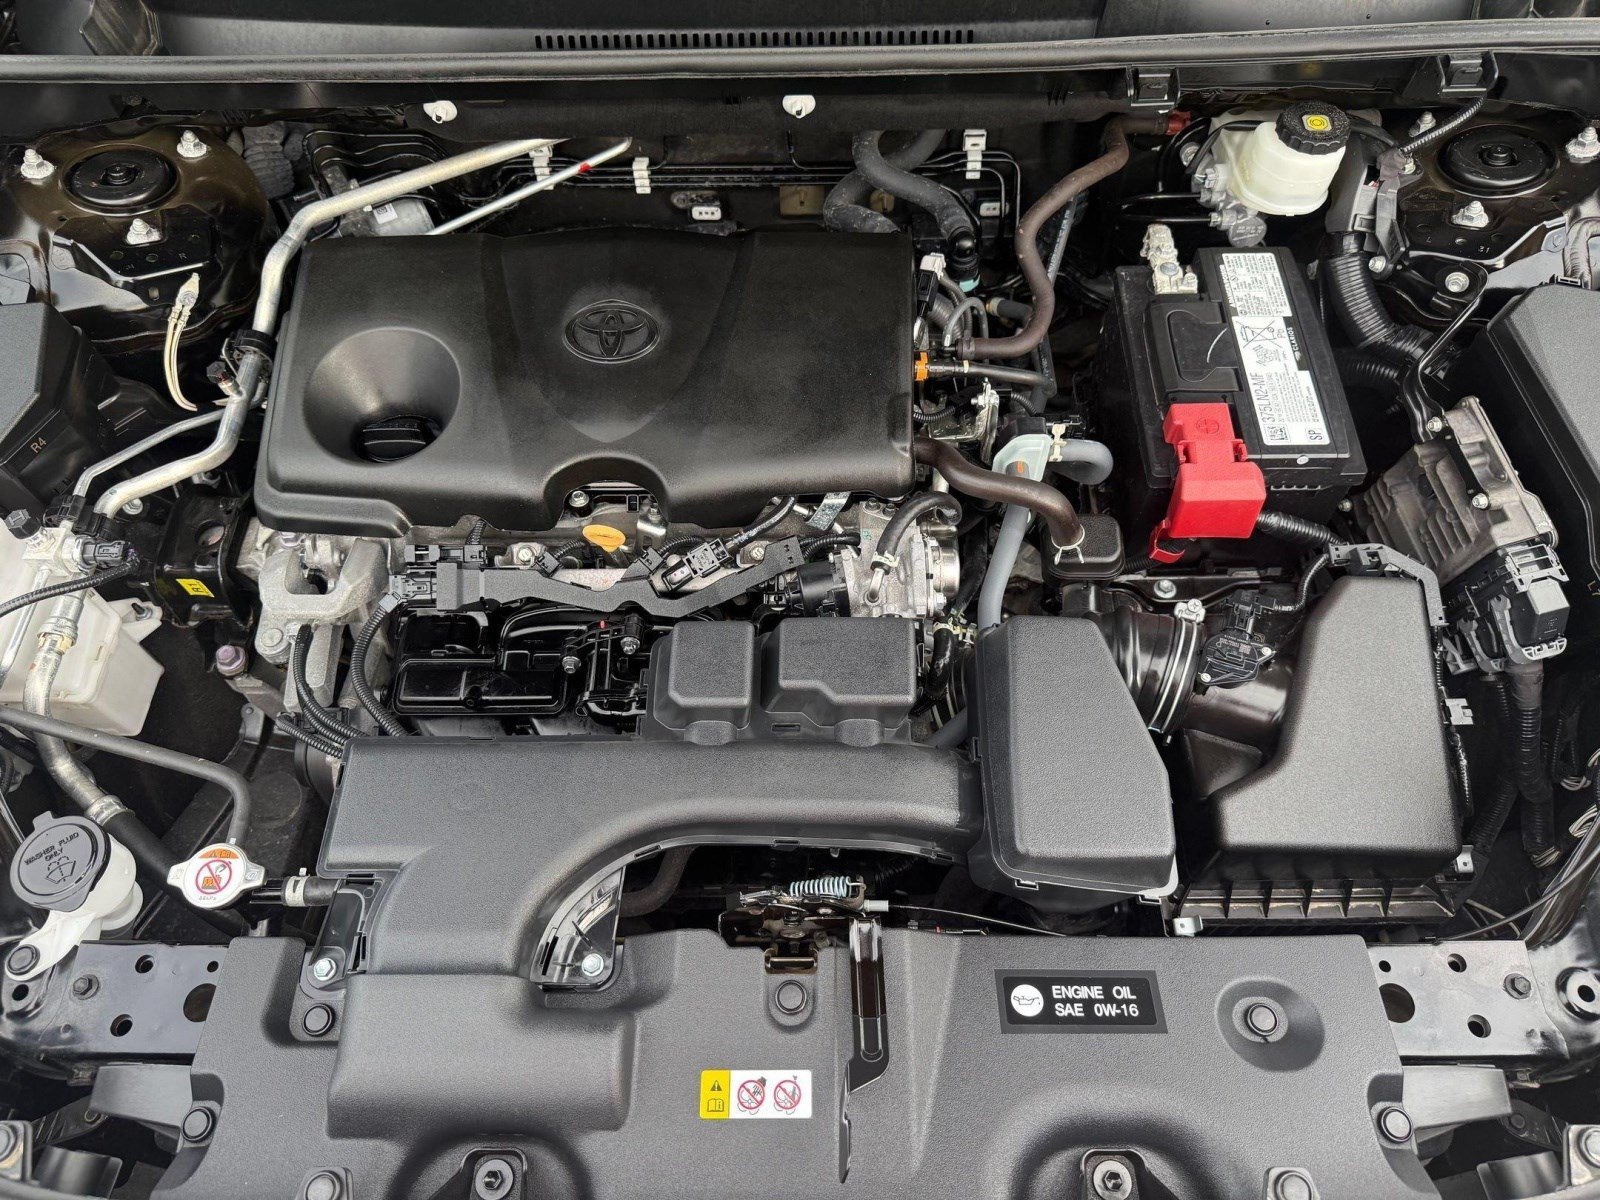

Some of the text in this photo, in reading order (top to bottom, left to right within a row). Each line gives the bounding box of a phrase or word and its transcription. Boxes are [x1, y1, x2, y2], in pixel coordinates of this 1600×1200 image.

[1277, 328, 1286, 339] Pb
[1287, 327, 1299, 350] CLARIOS
[1250, 372, 1275, 423] 375LN2-MF
[1308, 430, 1323, 441] SP
[30, 437, 46, 453] R4
[24, 832, 79, 865] WASHER FLUID
[45, 847, 63, 861] ONLY
[1051, 985, 1137, 999] ENGINE OIL
[1054, 1003, 1140, 1017] SAE 0W-16
